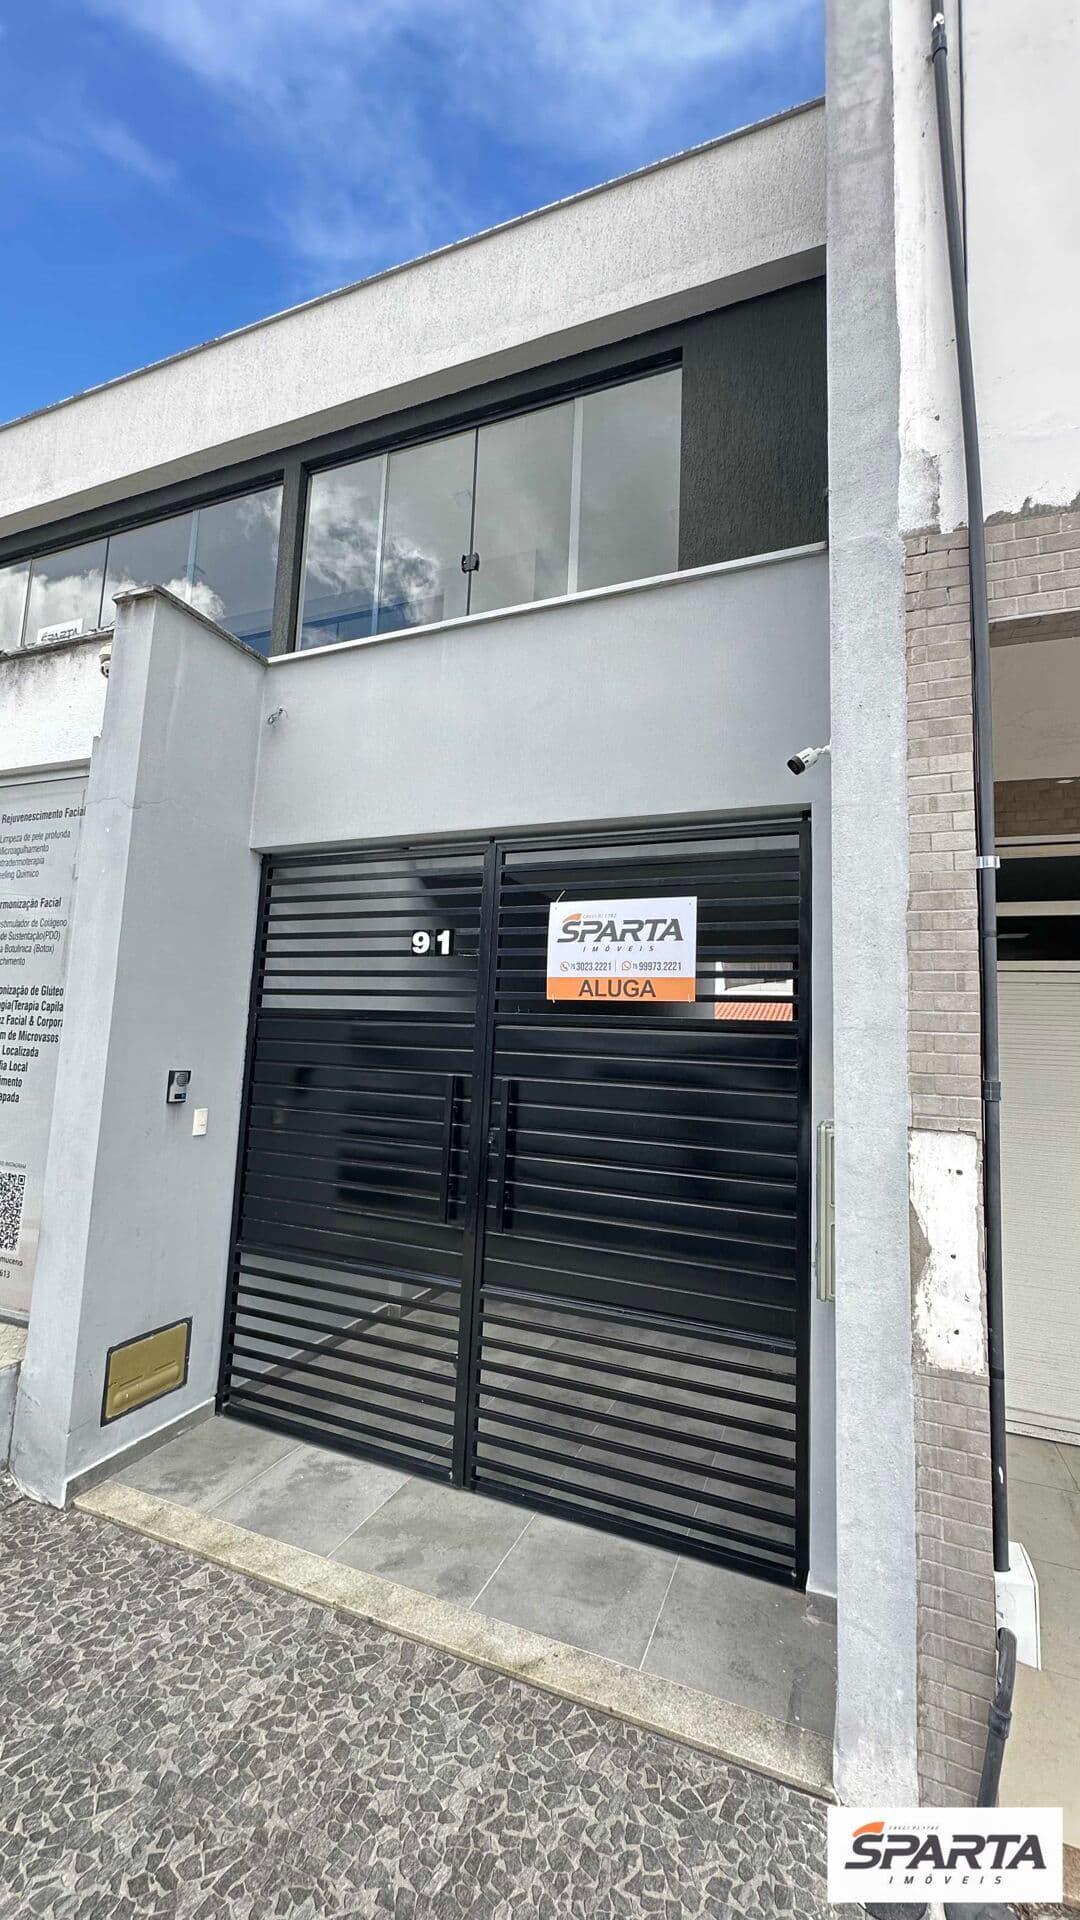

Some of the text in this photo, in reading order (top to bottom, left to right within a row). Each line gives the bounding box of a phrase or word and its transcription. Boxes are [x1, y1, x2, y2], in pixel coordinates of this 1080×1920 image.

[1, 806, 86, 825] Rejuvenescimento Facial
[40, 896, 62, 908] Facial
[557, 918, 684, 943] SPARTA
[412, 930, 450, 955] 91
[583, 945, 655, 953] IMÓVEIS
[31, 985, 40, 996] de
[578, 979, 656, 998] ALUGA
[6, 1014, 28, 1026] Facial
[29, 1015, 35, 1026] &
[8, 1029, 17, 1041] de
[18, 1030, 59, 1043] Microvasos
[2, 1044, 39, 1058] Localizada
[9, 1060, 28, 1072] Local
